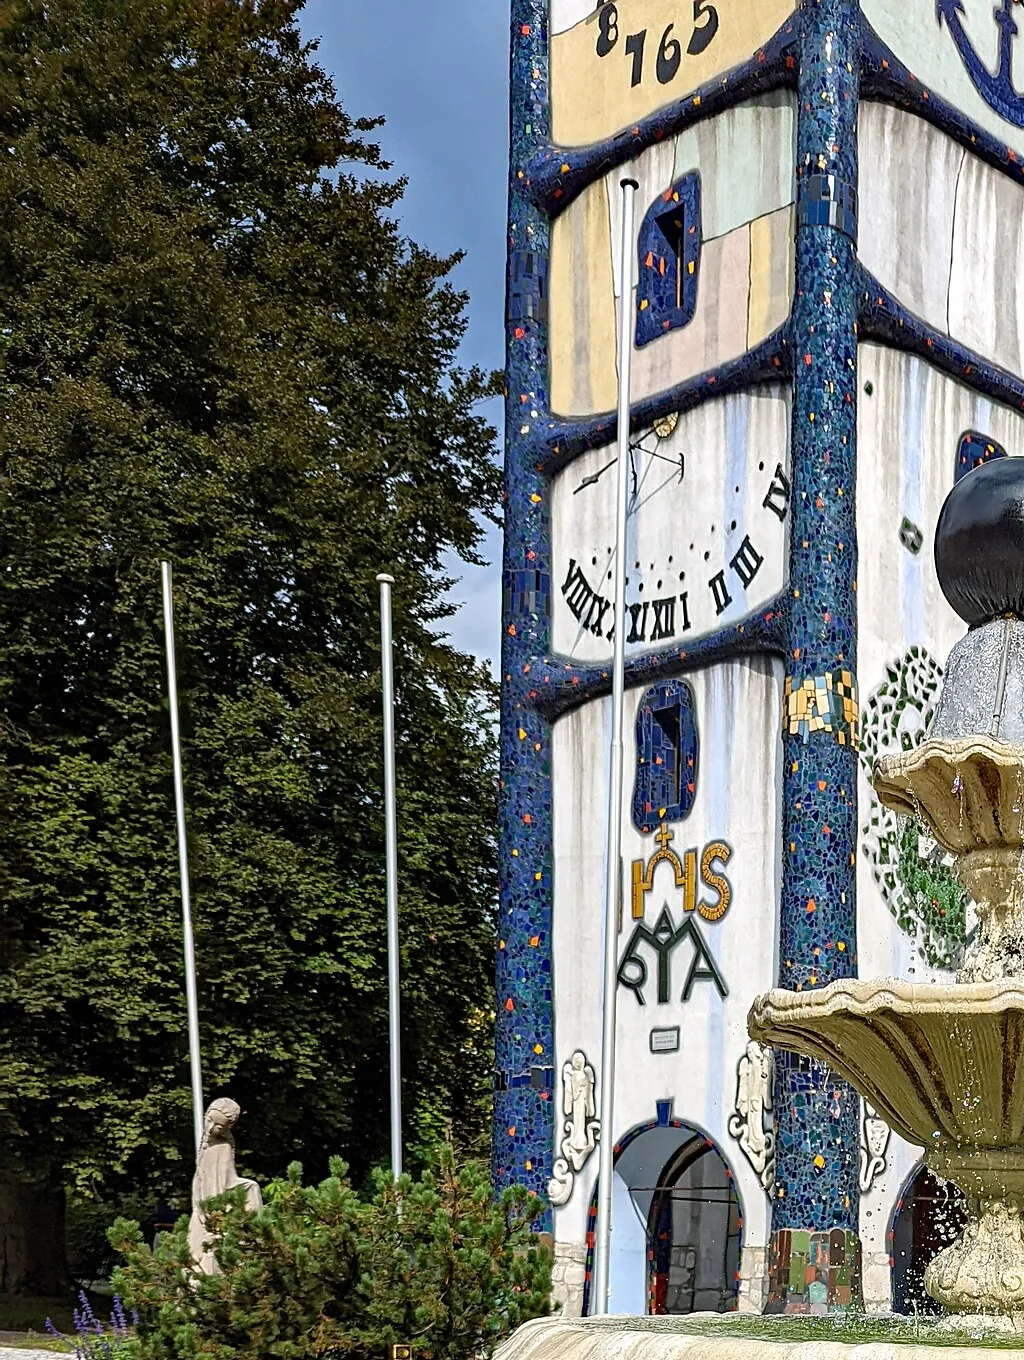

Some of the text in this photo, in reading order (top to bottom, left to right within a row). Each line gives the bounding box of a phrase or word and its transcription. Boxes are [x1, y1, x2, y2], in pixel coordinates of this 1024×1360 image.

[596, 0, 719, 88] 8 7 6 5
[680, 591, 691, 632] I
[708, 569, 732, 616] II
[729, 534, 764, 590] III
